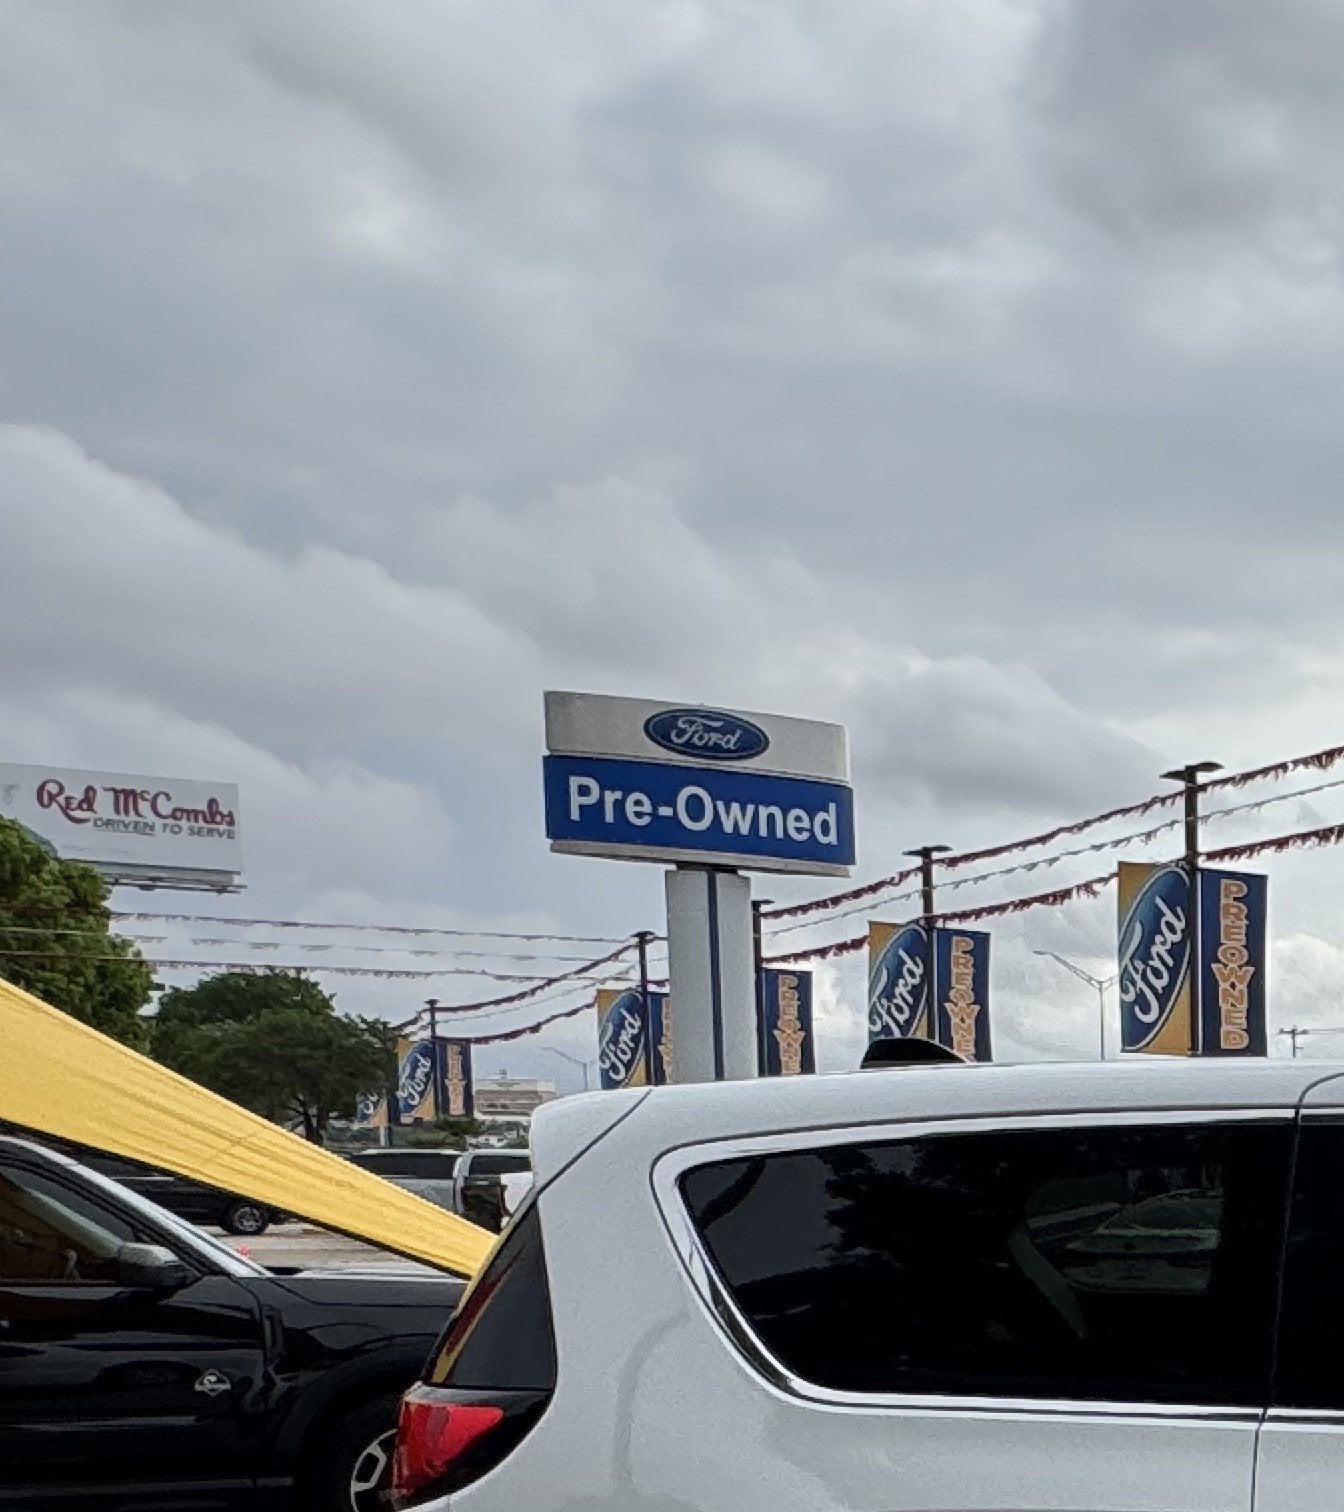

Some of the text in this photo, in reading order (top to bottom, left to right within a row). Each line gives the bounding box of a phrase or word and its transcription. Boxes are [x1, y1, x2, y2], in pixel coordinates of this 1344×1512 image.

[670, 715, 743, 750] Ford
[36, 778, 236, 827] Red McCombs
[93, 817, 236, 840] DRIVEN TO SERVE
[567, 775, 839, 846] Pre-Owned
[869, 948, 924, 1037] Ford
[1120, 894, 1187, 1024] Ford
[1210, 878, 1256, 1050] PREOWNED
[943, 936, 982, 1062] PREOWNE
[600, 1008, 642, 1081] Ford
